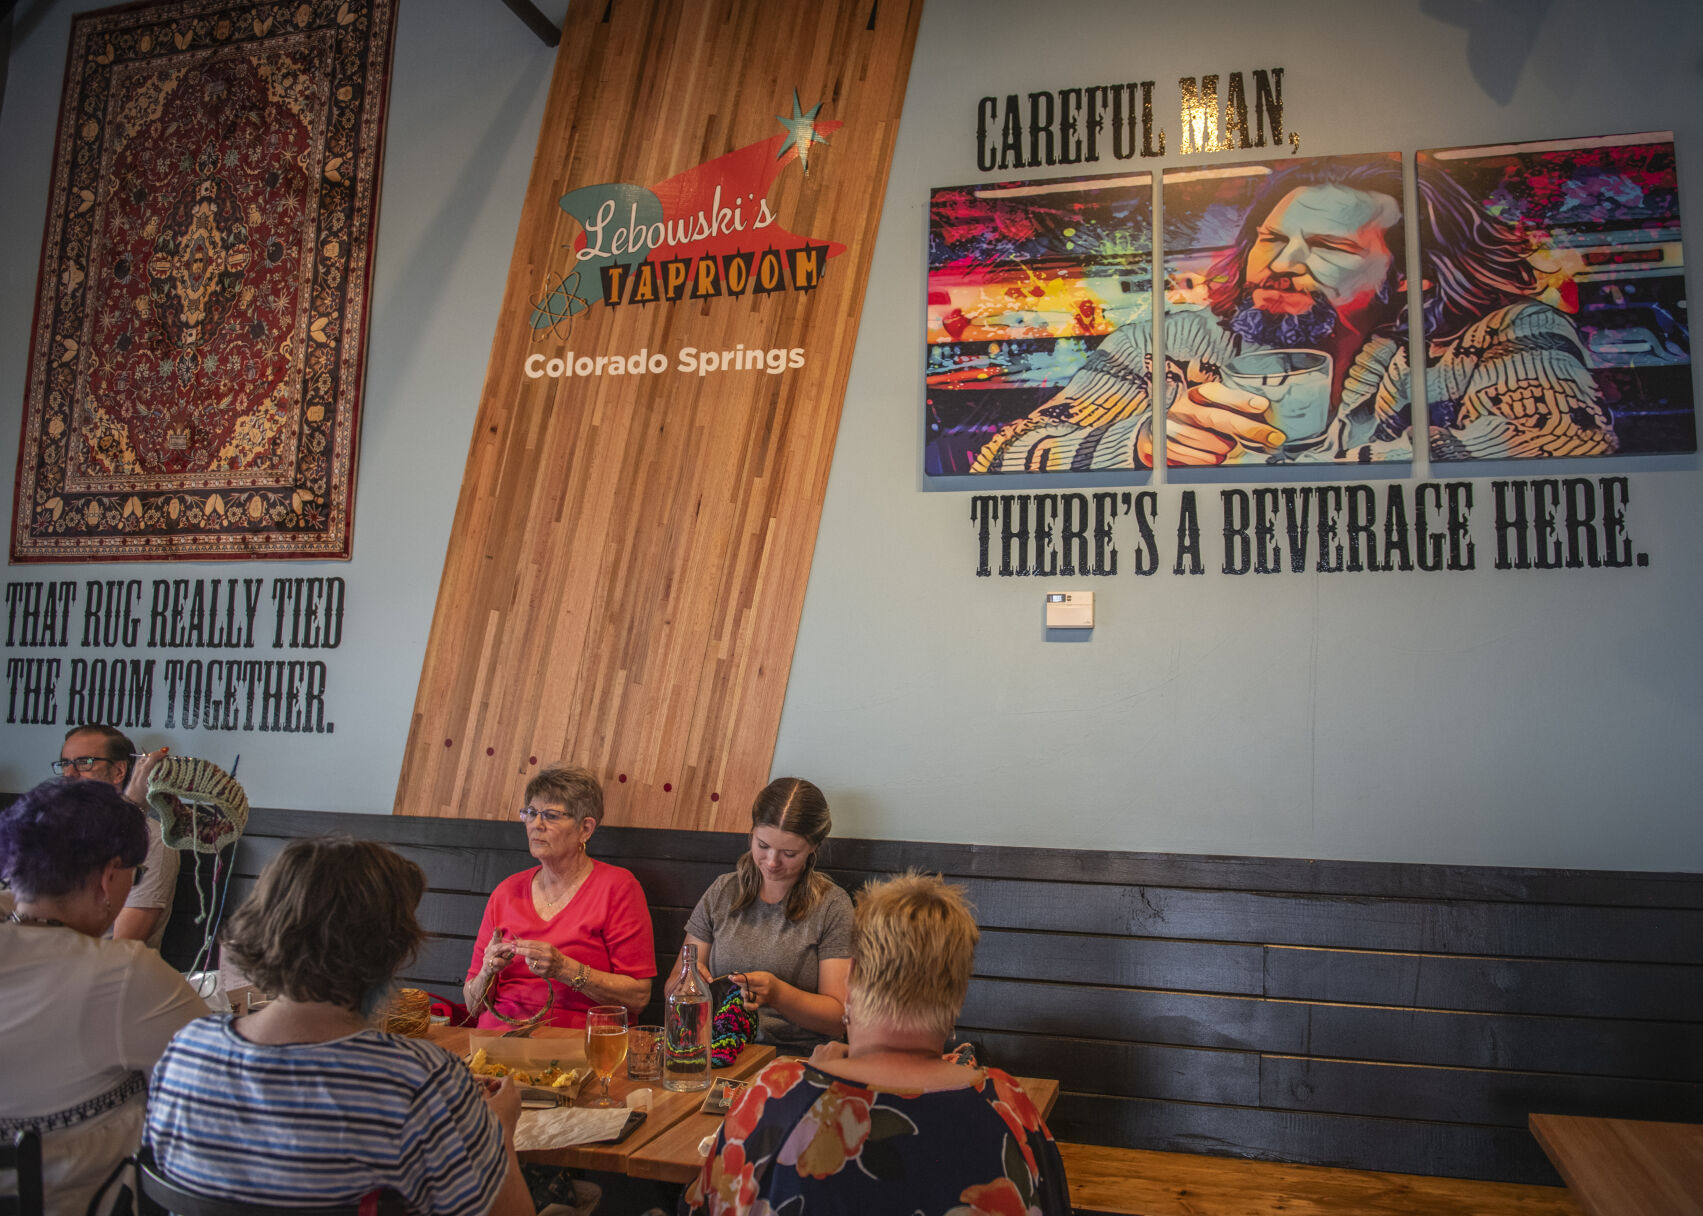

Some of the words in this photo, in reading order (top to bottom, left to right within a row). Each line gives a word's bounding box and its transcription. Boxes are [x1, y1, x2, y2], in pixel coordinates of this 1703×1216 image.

[976, 80, 1166, 172] CAREFUL
[1178, 67, 1300, 154] MAN,
[576, 185, 777, 261] Lebowski's
[608, 250, 818, 304] TAPROOM
[524, 349, 668, 378] Colorado
[678, 344, 805, 376] Springs
[970, 491, 1159, 577] THERE'S
[1173, 490, 1205, 575] A
[1220, 482, 1476, 575] BEVERAGE
[1491, 477, 1649, 569] HERE.
[6, 580, 77, 648] THAT
[81, 579, 142, 648] RUG
[147, 577, 264, 649] REALLY
[271, 576, 346, 649] TIED
[6, 657, 61, 725] THE
[65, 658, 156, 728] ROOM
[164, 659, 335, 733] TOGETHER.
